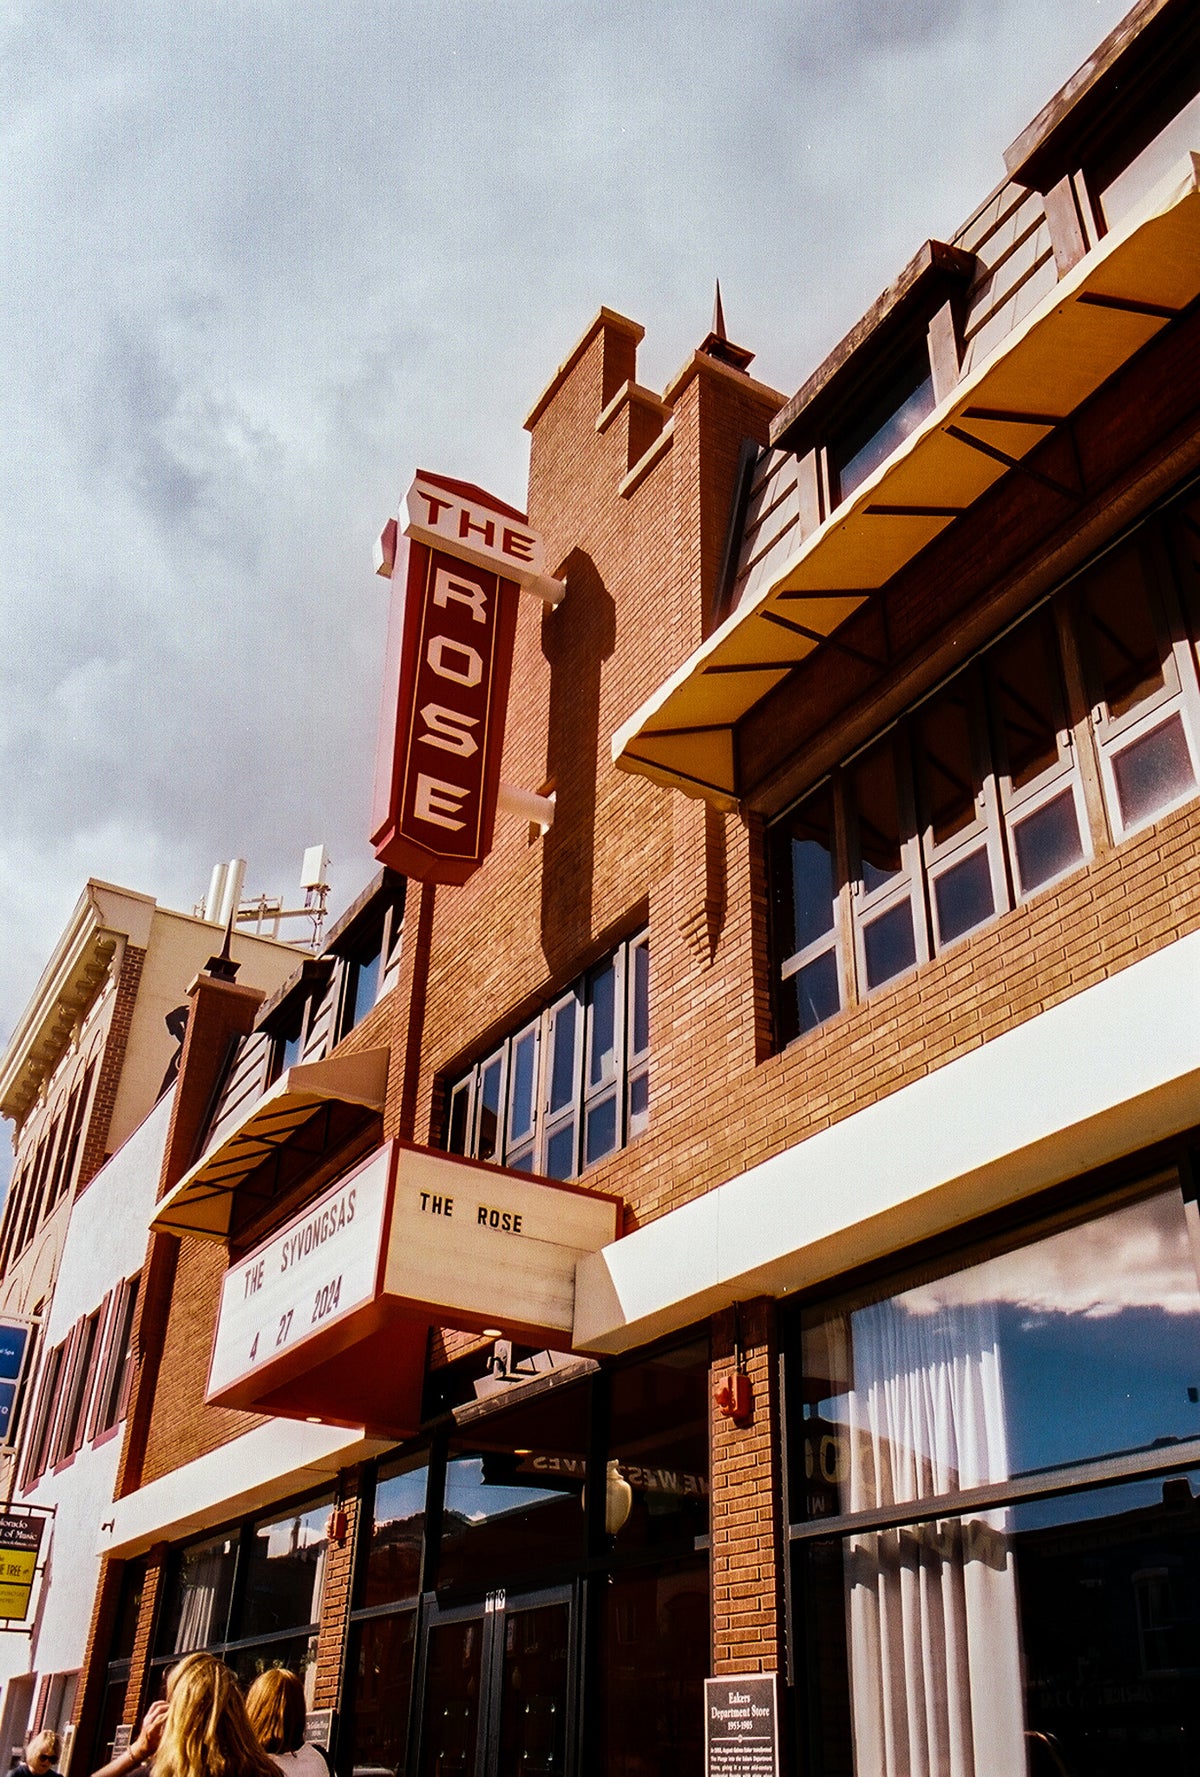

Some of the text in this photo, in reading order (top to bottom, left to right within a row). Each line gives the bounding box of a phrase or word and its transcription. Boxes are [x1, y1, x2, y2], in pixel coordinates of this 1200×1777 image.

[416, 489, 537, 562] THE
[413, 567, 488, 832] ROSE
[243, 1188, 357, 1299] THE SYVONGSAS
[420, 1191, 523, 1233] THE ROSE
[249, 1274, 343, 1361] 4 27 2024
[711, 1704, 770, 1721] Department Store
